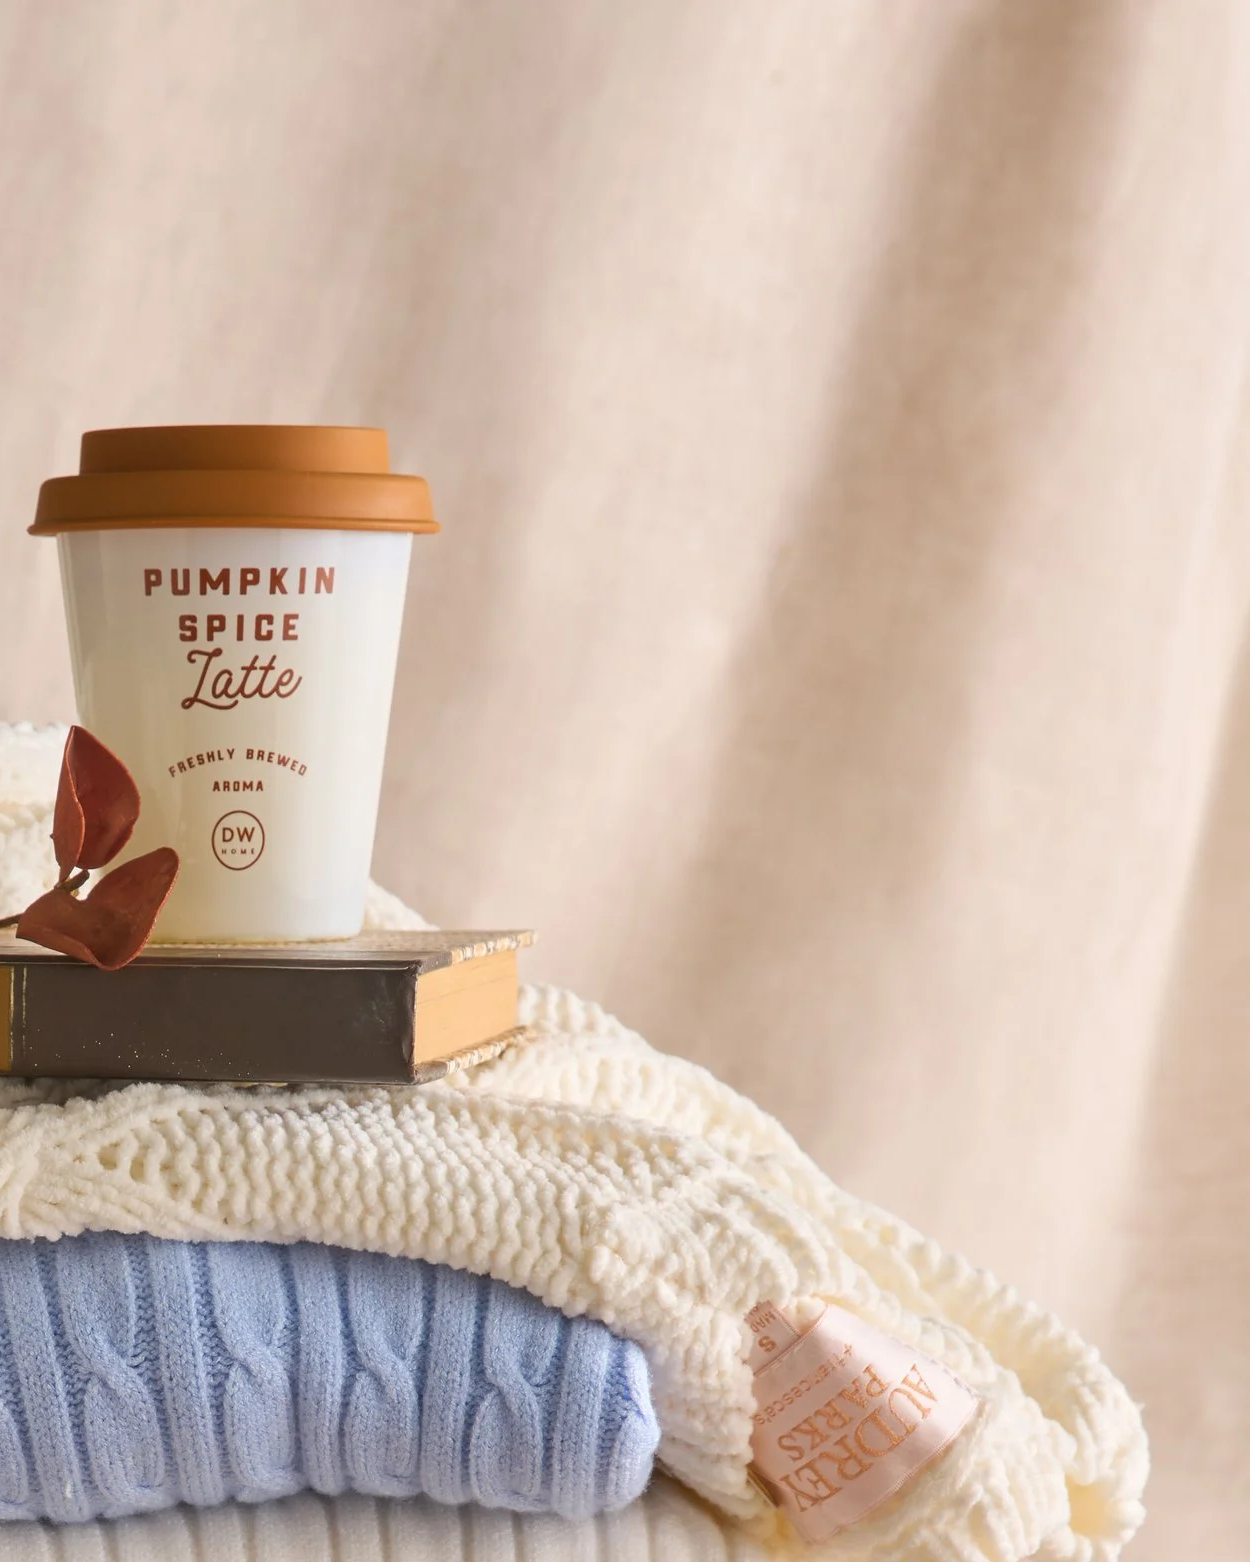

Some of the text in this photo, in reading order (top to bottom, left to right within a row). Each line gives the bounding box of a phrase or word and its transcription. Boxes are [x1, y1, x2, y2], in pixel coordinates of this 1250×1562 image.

[143, 566, 336, 597] PUMPKIN
[178, 613, 300, 642] SPICE
[180, 647, 303, 711] Latte
[168, 748, 308, 778] FRESHLY BREWED
[212, 780, 264, 792] AROMA
[221, 826, 256, 843] DW
[758, 1335, 776, 1352] S
[777, 1364, 888, 1462] PARKS
[780, 1363, 938, 1512] AUDREY
